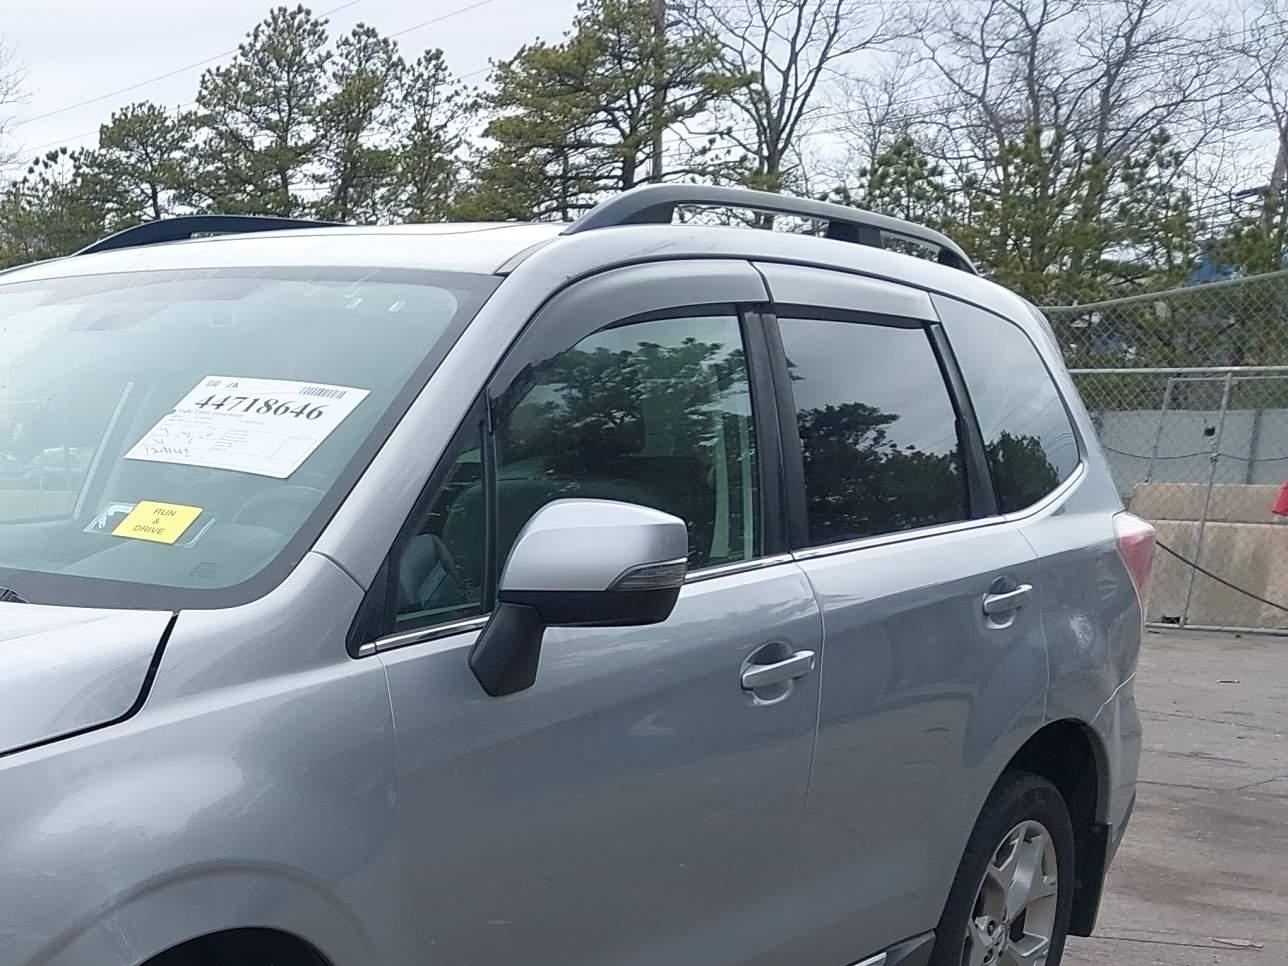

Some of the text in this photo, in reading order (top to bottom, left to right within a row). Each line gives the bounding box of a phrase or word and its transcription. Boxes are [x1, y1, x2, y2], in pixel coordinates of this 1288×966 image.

[195, 394, 329, 420] 44718646
[153, 508, 178, 517] RUN
[133, 525, 167, 535] DRIVE
